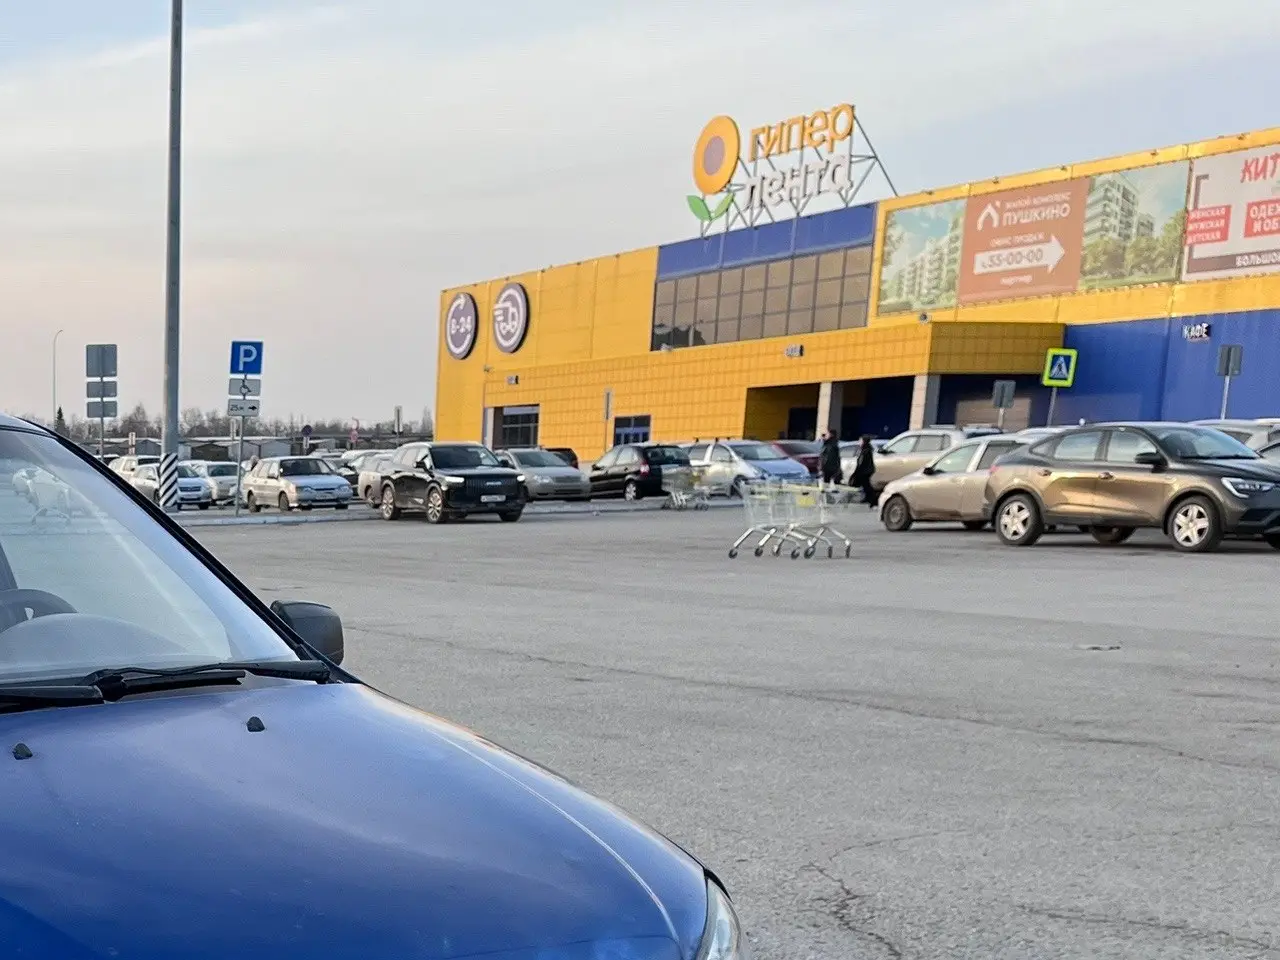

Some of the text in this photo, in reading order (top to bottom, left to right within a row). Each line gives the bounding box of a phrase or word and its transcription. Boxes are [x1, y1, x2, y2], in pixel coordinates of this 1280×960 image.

[748, 103, 855, 163] гипер
[1002, 202, 1071, 227] ПУШКИНО
[238, 344, 257, 371] P
